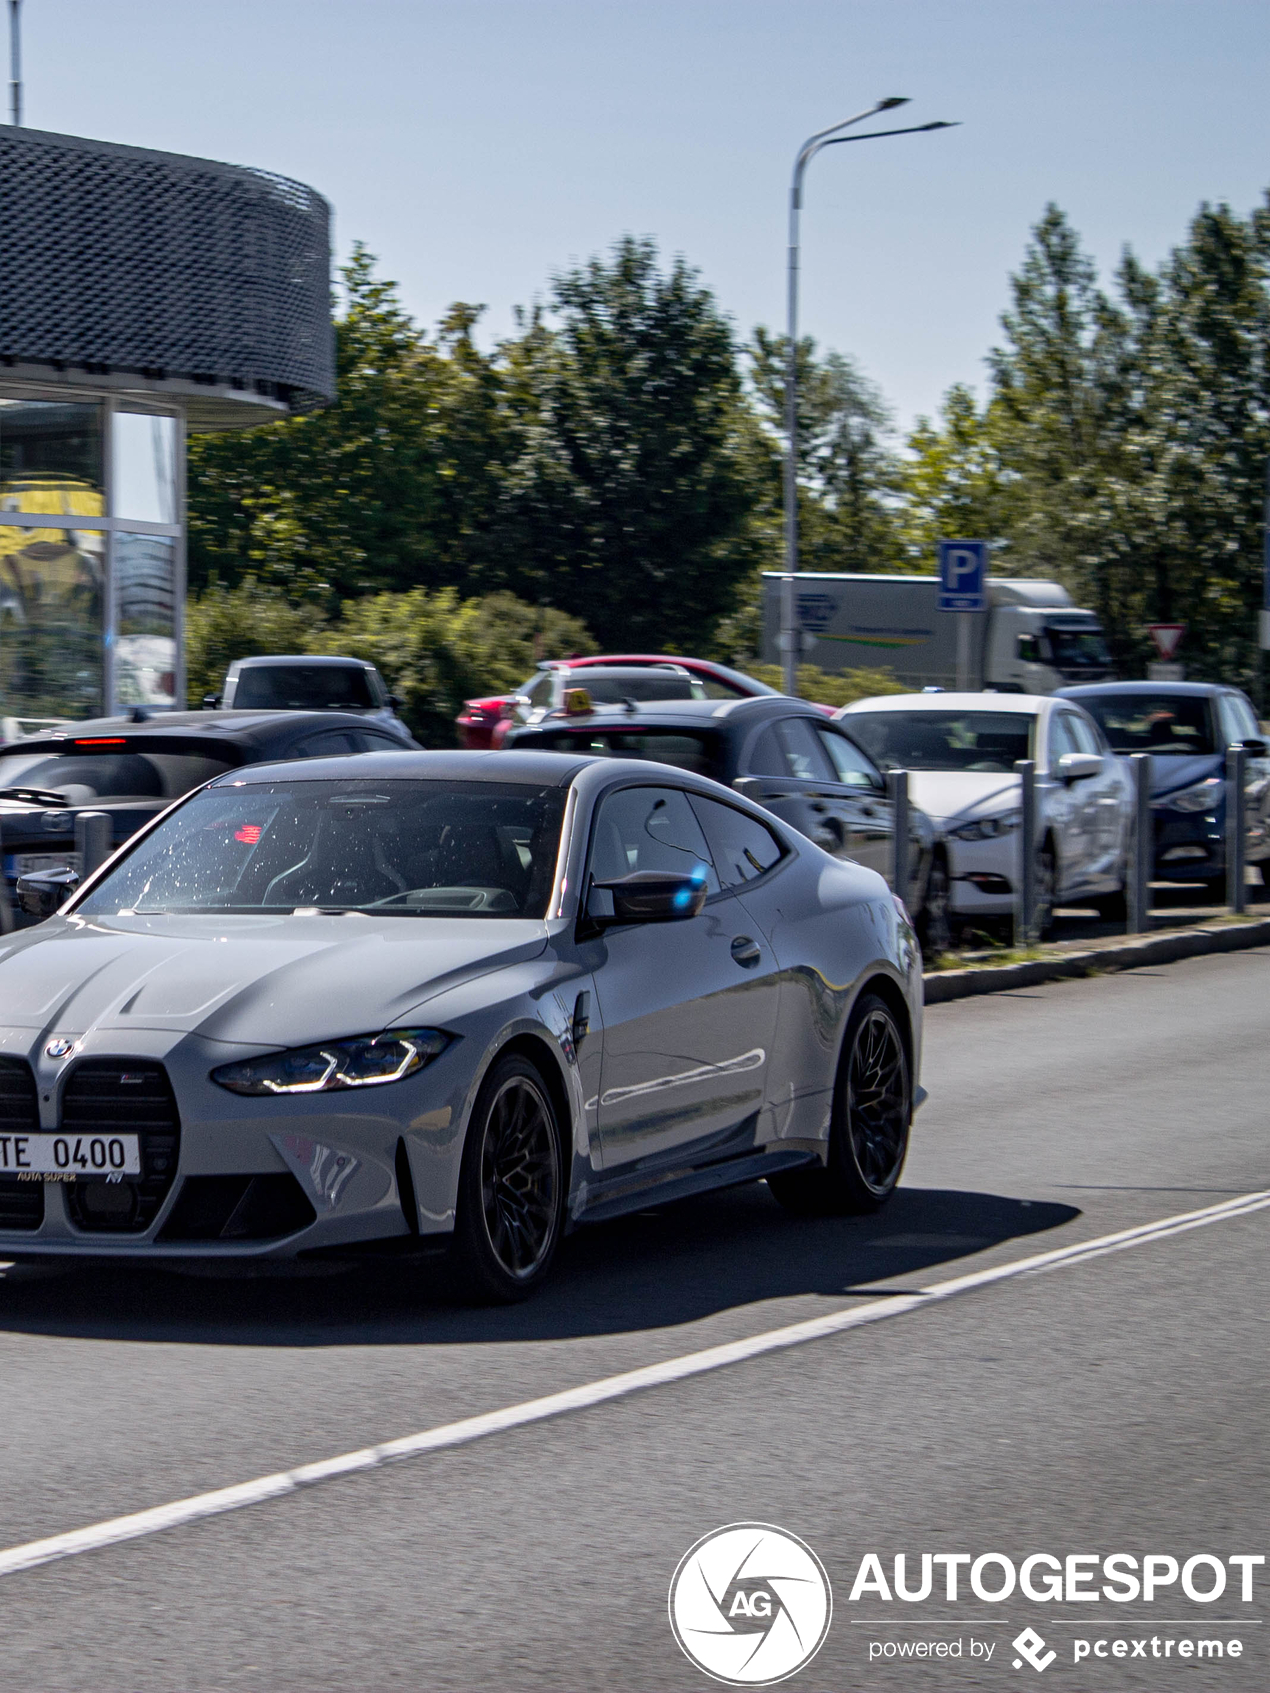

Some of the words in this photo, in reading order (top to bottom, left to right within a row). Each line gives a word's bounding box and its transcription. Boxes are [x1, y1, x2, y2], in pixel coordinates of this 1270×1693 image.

[946, 549, 977, 590] P
[53, 1137, 126, 1169] 0400
[44, 1172, 77, 1183] SUPER
